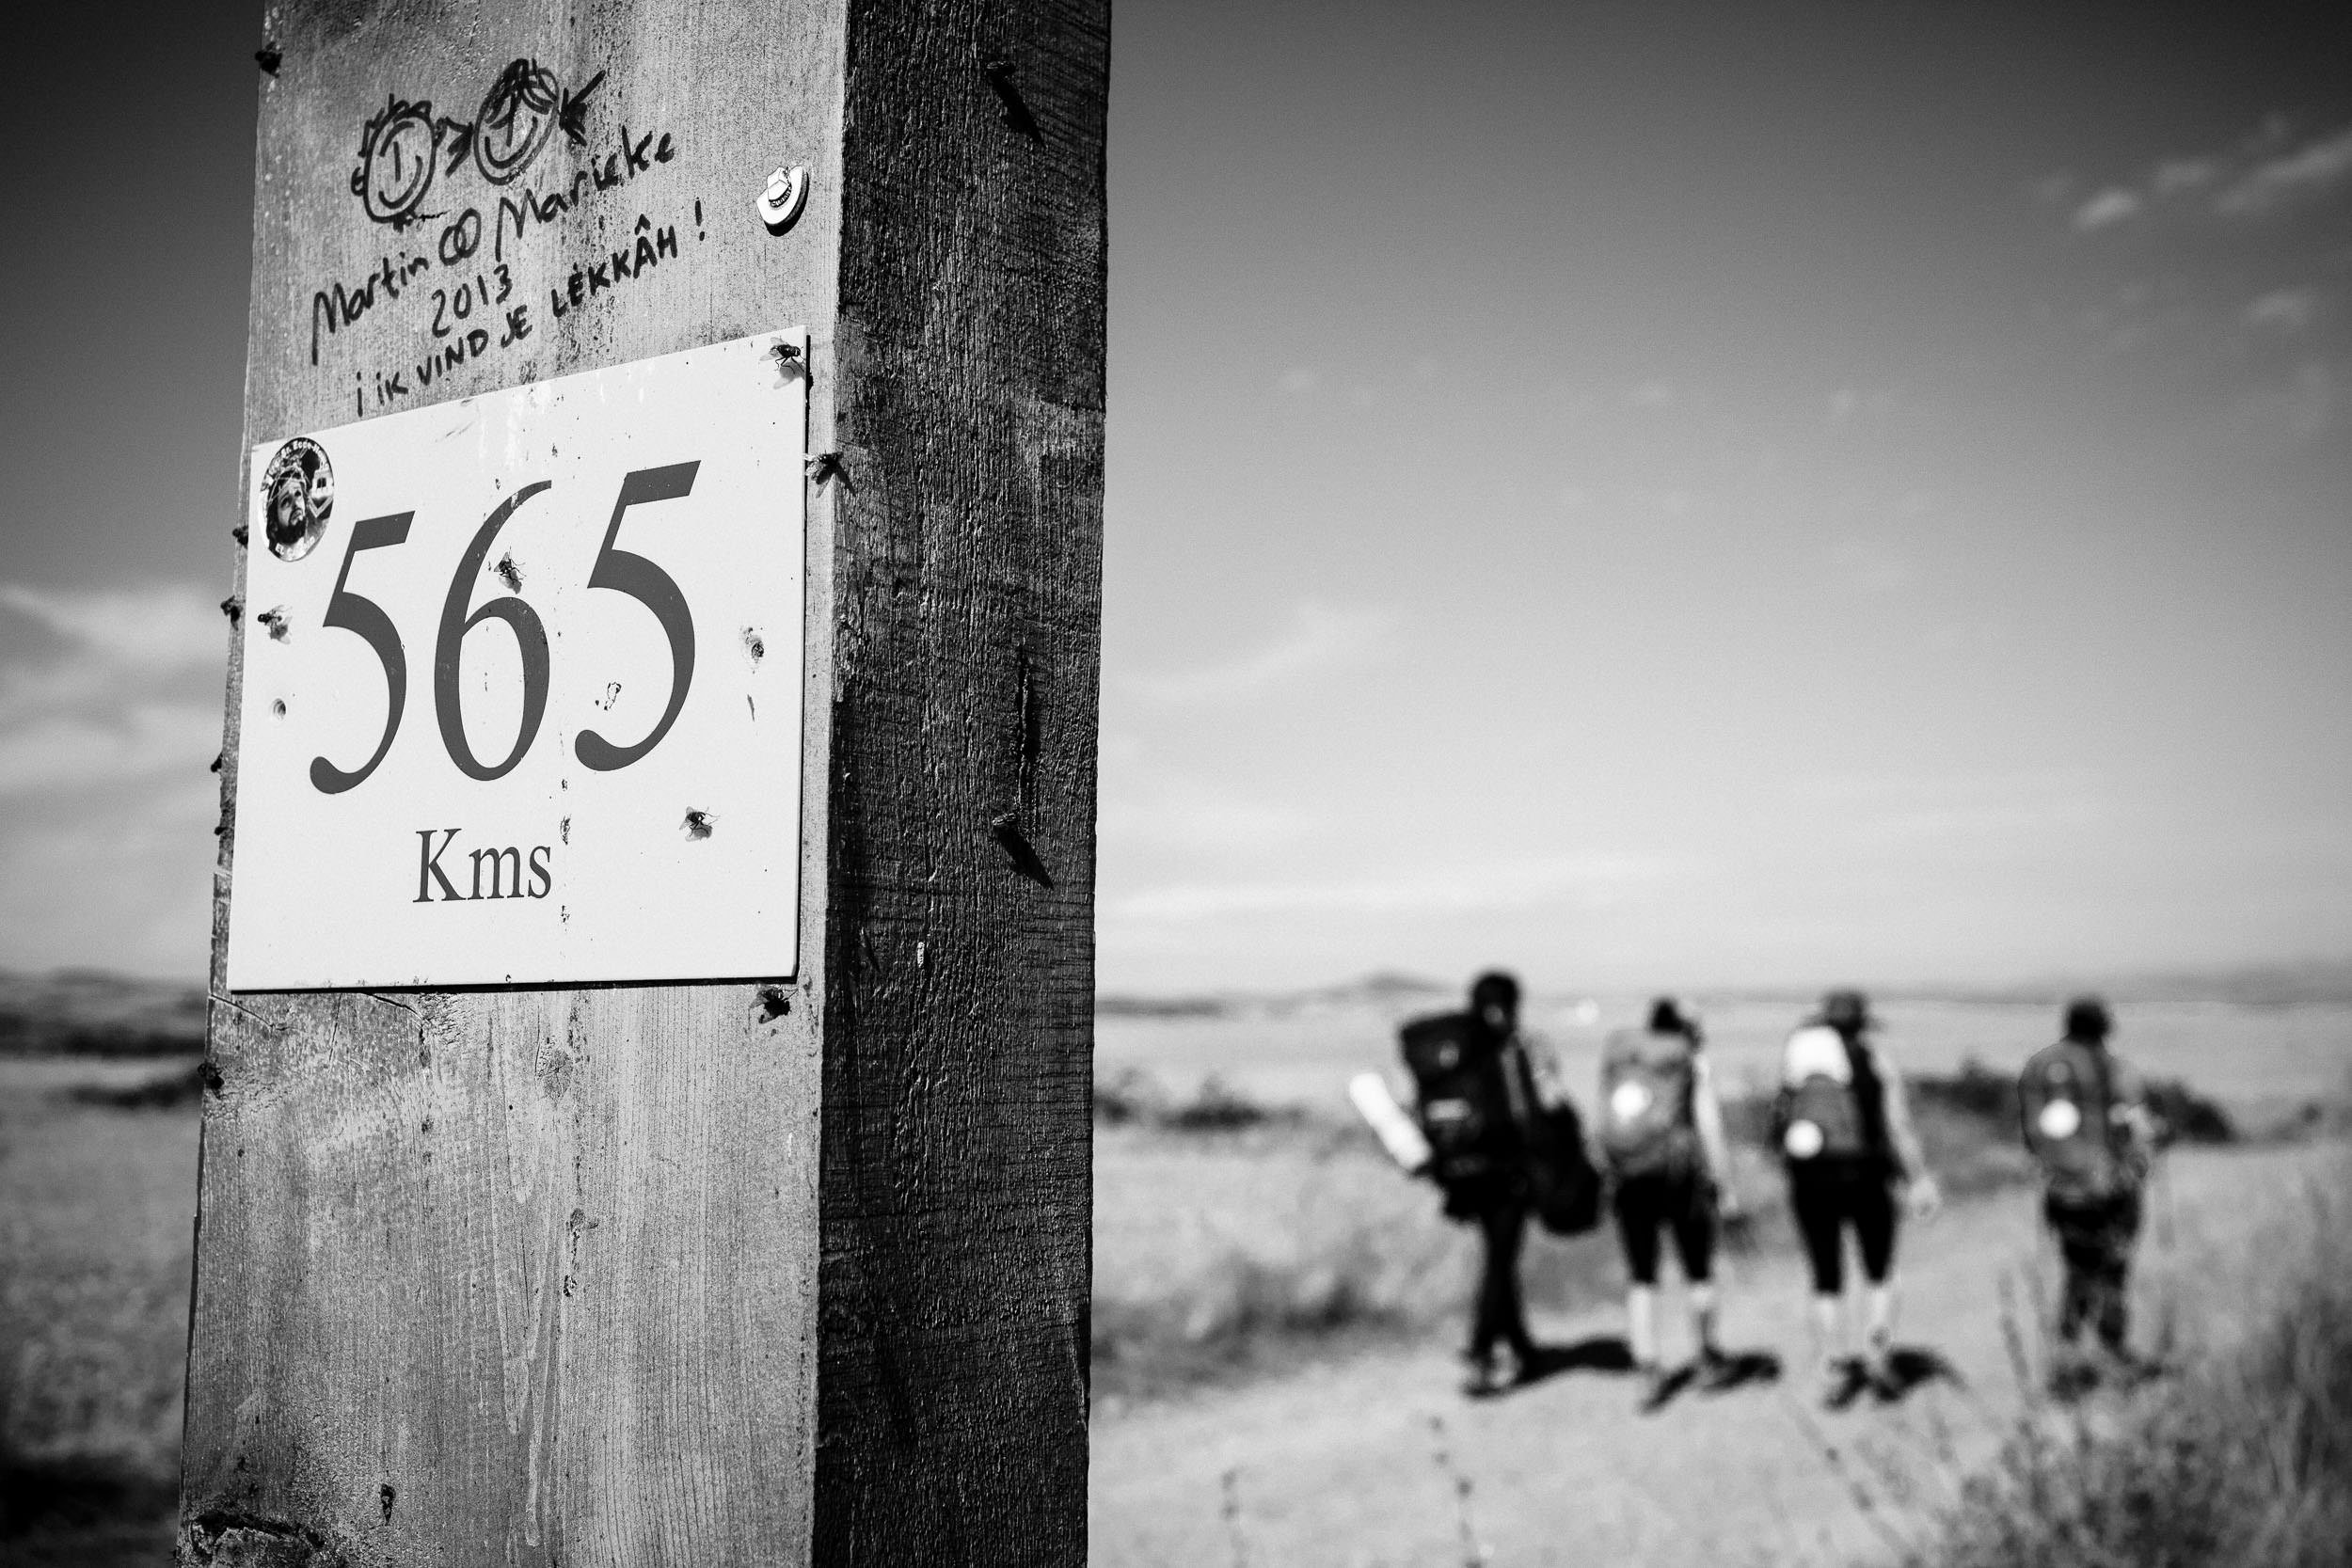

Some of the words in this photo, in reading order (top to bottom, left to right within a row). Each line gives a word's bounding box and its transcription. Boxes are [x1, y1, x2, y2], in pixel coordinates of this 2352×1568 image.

[312, 251, 429, 366] Martin
[495, 125, 675, 262] Marieke
[431, 263, 514, 338] 2013
[417, 329, 489, 387] VIND
[501, 305, 533, 348] JE
[310, 460, 702, 795] 565
[412, 828, 552, 903] Kms
